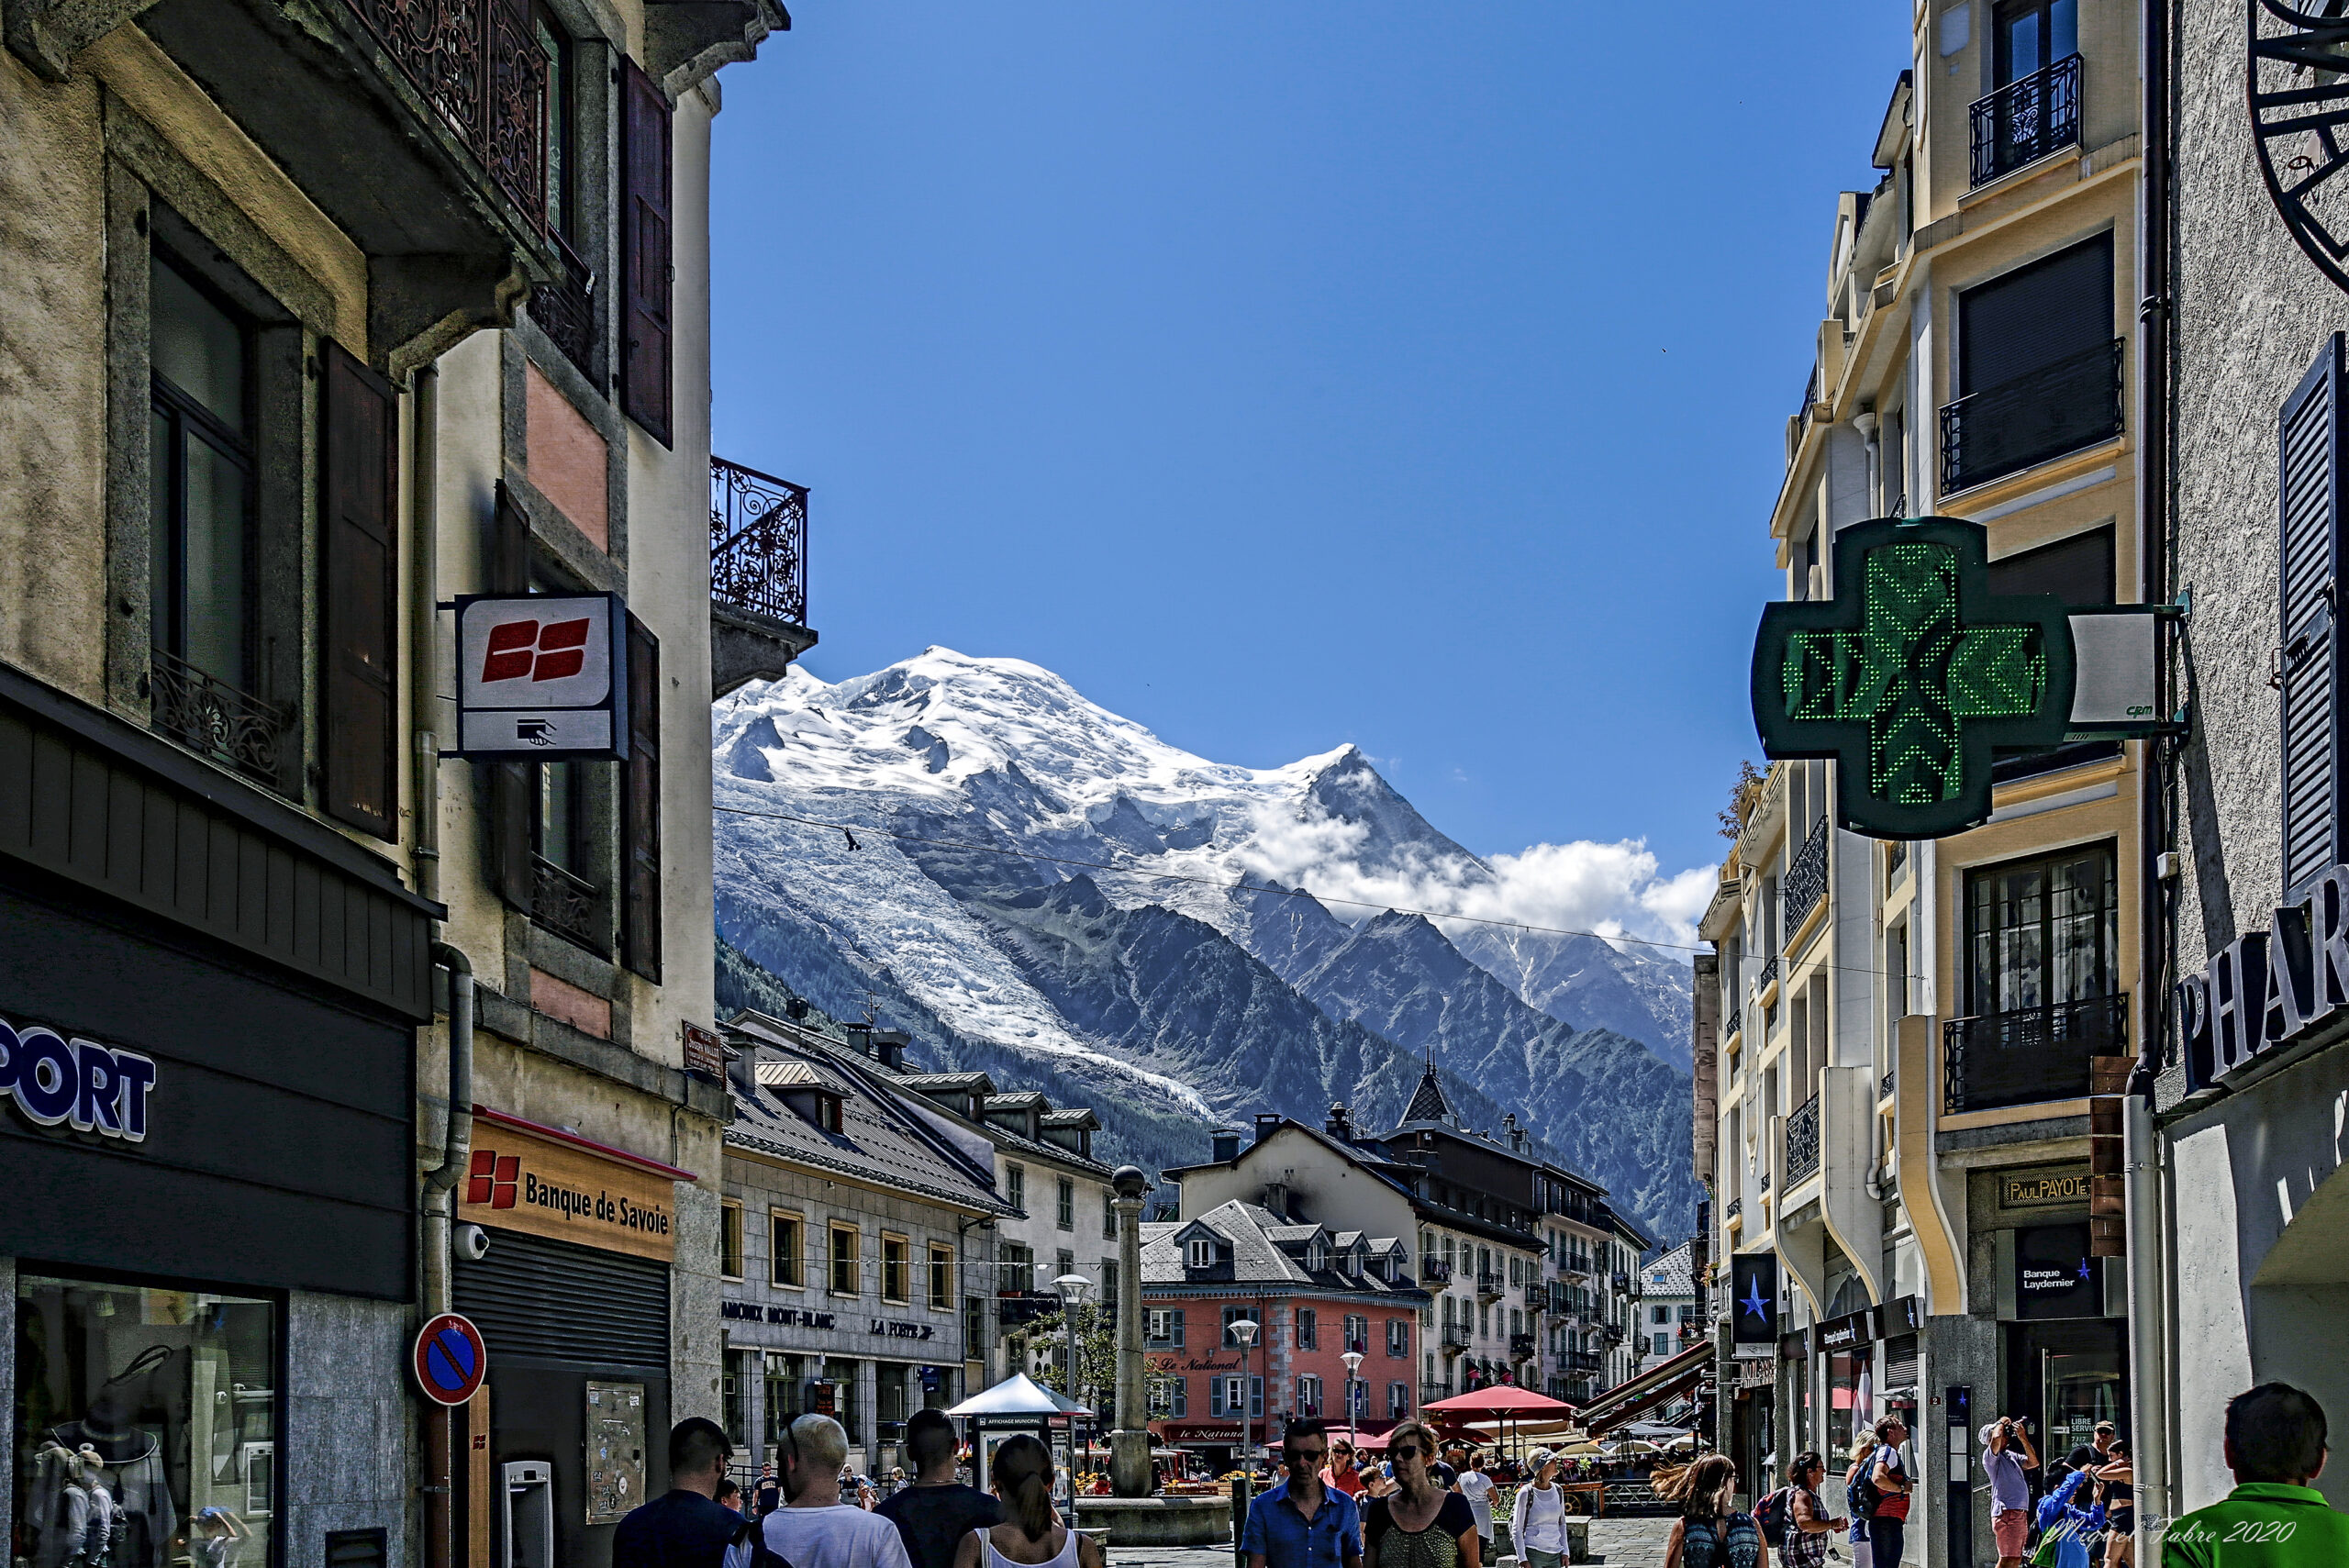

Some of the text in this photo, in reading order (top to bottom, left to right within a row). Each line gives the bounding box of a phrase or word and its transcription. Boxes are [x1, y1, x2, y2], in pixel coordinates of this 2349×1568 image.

[2040, 1177, 2083, 1198] PAYOT
[526, 1173, 668, 1235] Banque de Savoie
[2023, 1270, 2060, 1279] Banque
[2023, 1278, 2075, 1290] Laydernier
[768, 1307, 835, 1329] MONT-BLANC
[871, 1319, 919, 1339] LA POSTE
[1159, 1358, 1240, 1371] Le National
[1195, 1430, 1245, 1440] Nationa
